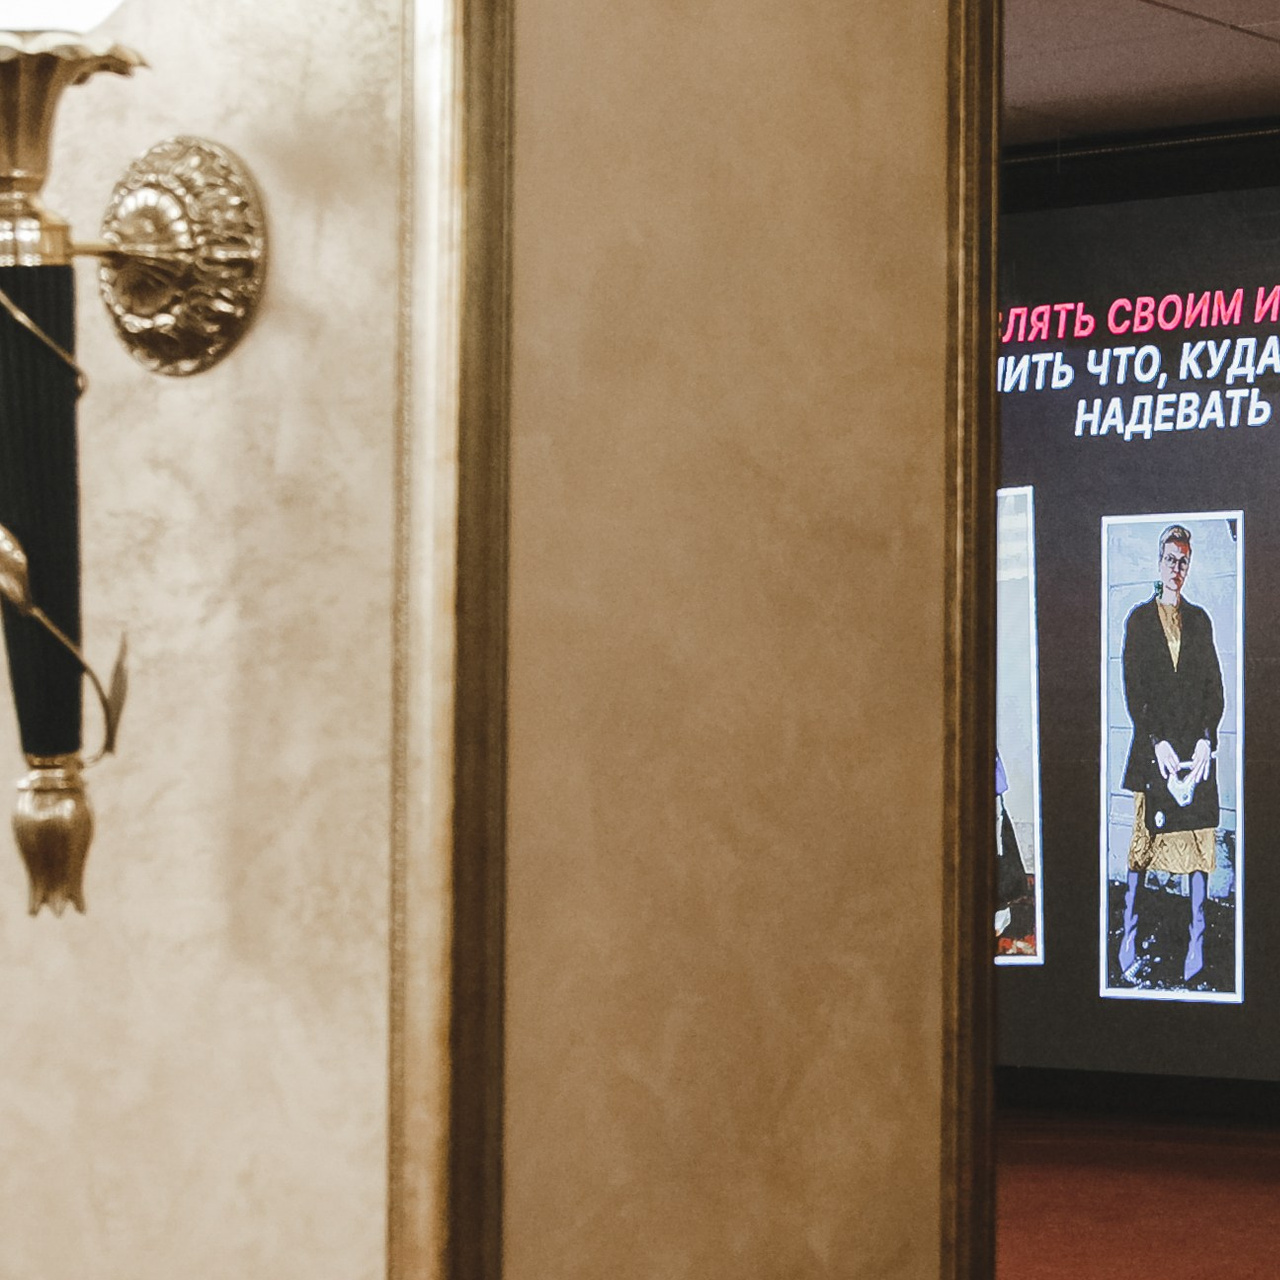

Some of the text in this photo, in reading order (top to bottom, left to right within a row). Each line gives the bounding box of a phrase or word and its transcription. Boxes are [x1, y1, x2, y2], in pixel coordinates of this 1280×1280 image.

[998, 302, 1096, 343] ЛЯТЬ
[1107, 287, 1244, 335] СВОИМ
[1086, 344, 1168, 390] ЧТО,
[1074, 388, 1272, 441] НАДЕВАТЬ
